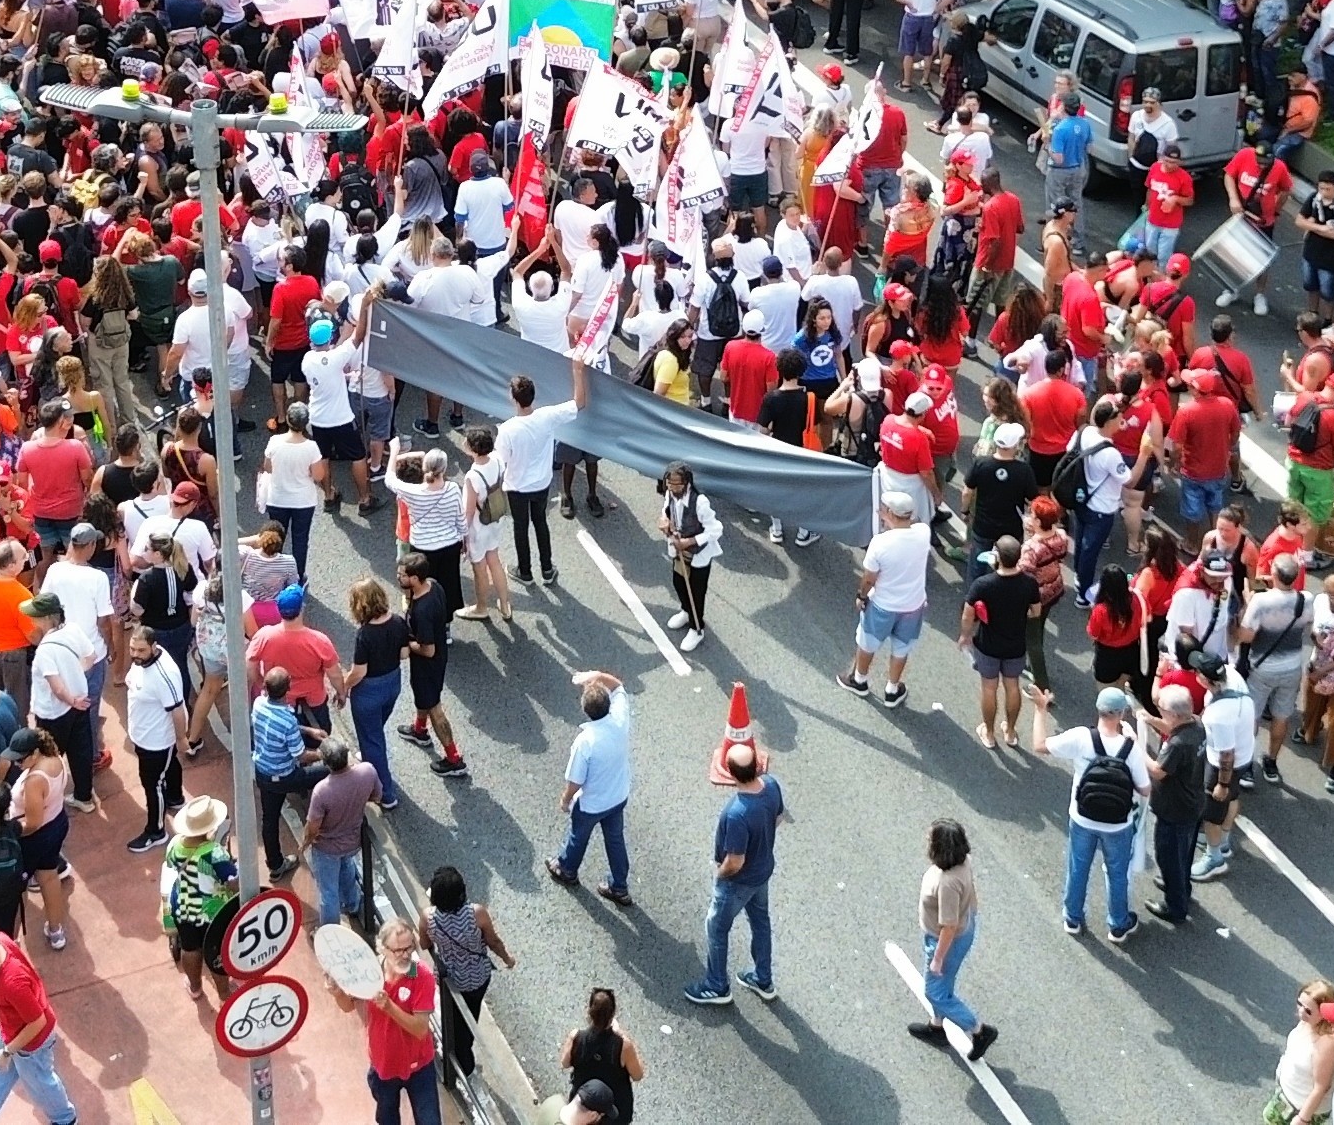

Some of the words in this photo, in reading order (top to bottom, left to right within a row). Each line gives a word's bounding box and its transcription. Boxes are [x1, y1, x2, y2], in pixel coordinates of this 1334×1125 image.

[729, 730, 746, 739] CET
[237, 903, 289, 959] 50
[250, 944, 279, 966] km/h
